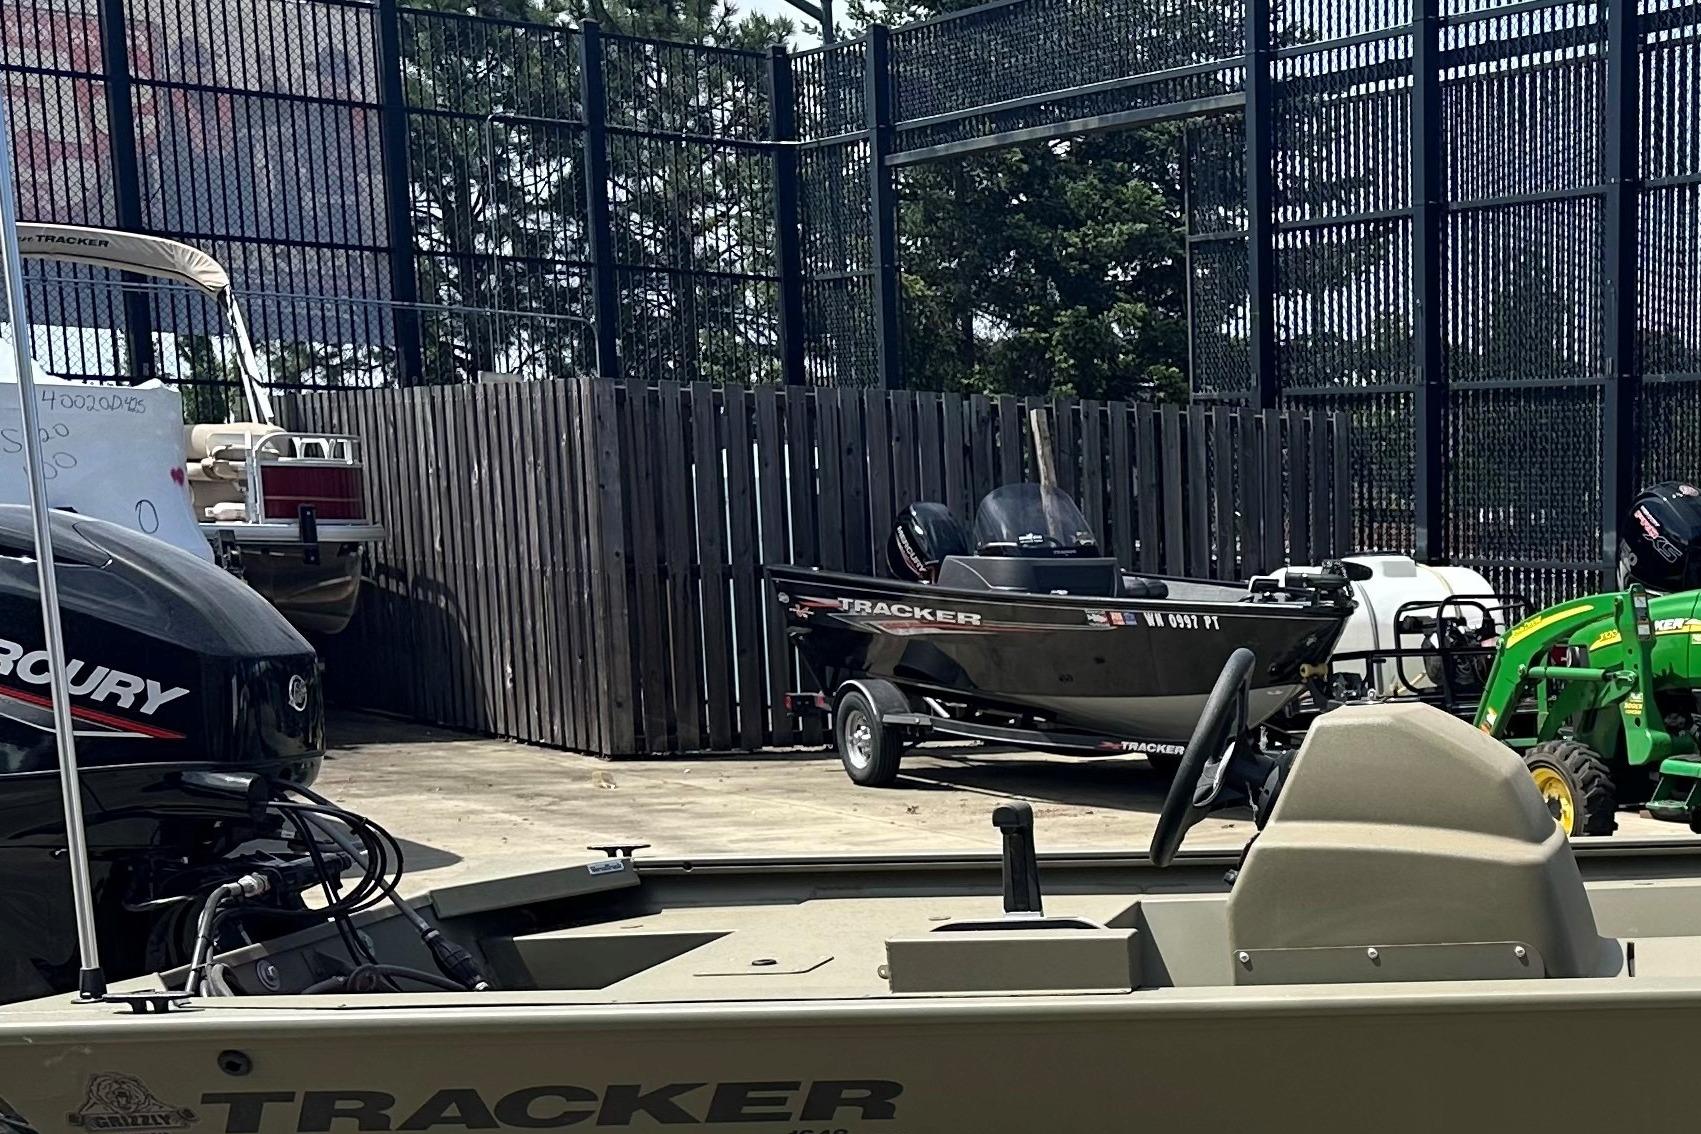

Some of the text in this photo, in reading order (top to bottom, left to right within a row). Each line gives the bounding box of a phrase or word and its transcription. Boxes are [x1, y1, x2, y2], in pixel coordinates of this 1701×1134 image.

[36, 233, 110, 248] TRACKER
[896, 525, 927, 573] MERCURY
[837, 597, 982, 625] TRACKER
[1121, 741, 1185, 755] TRACKER
[200, 1079, 904, 1134] TRACKER
[96, 1113, 172, 1129] GRIZZLY
